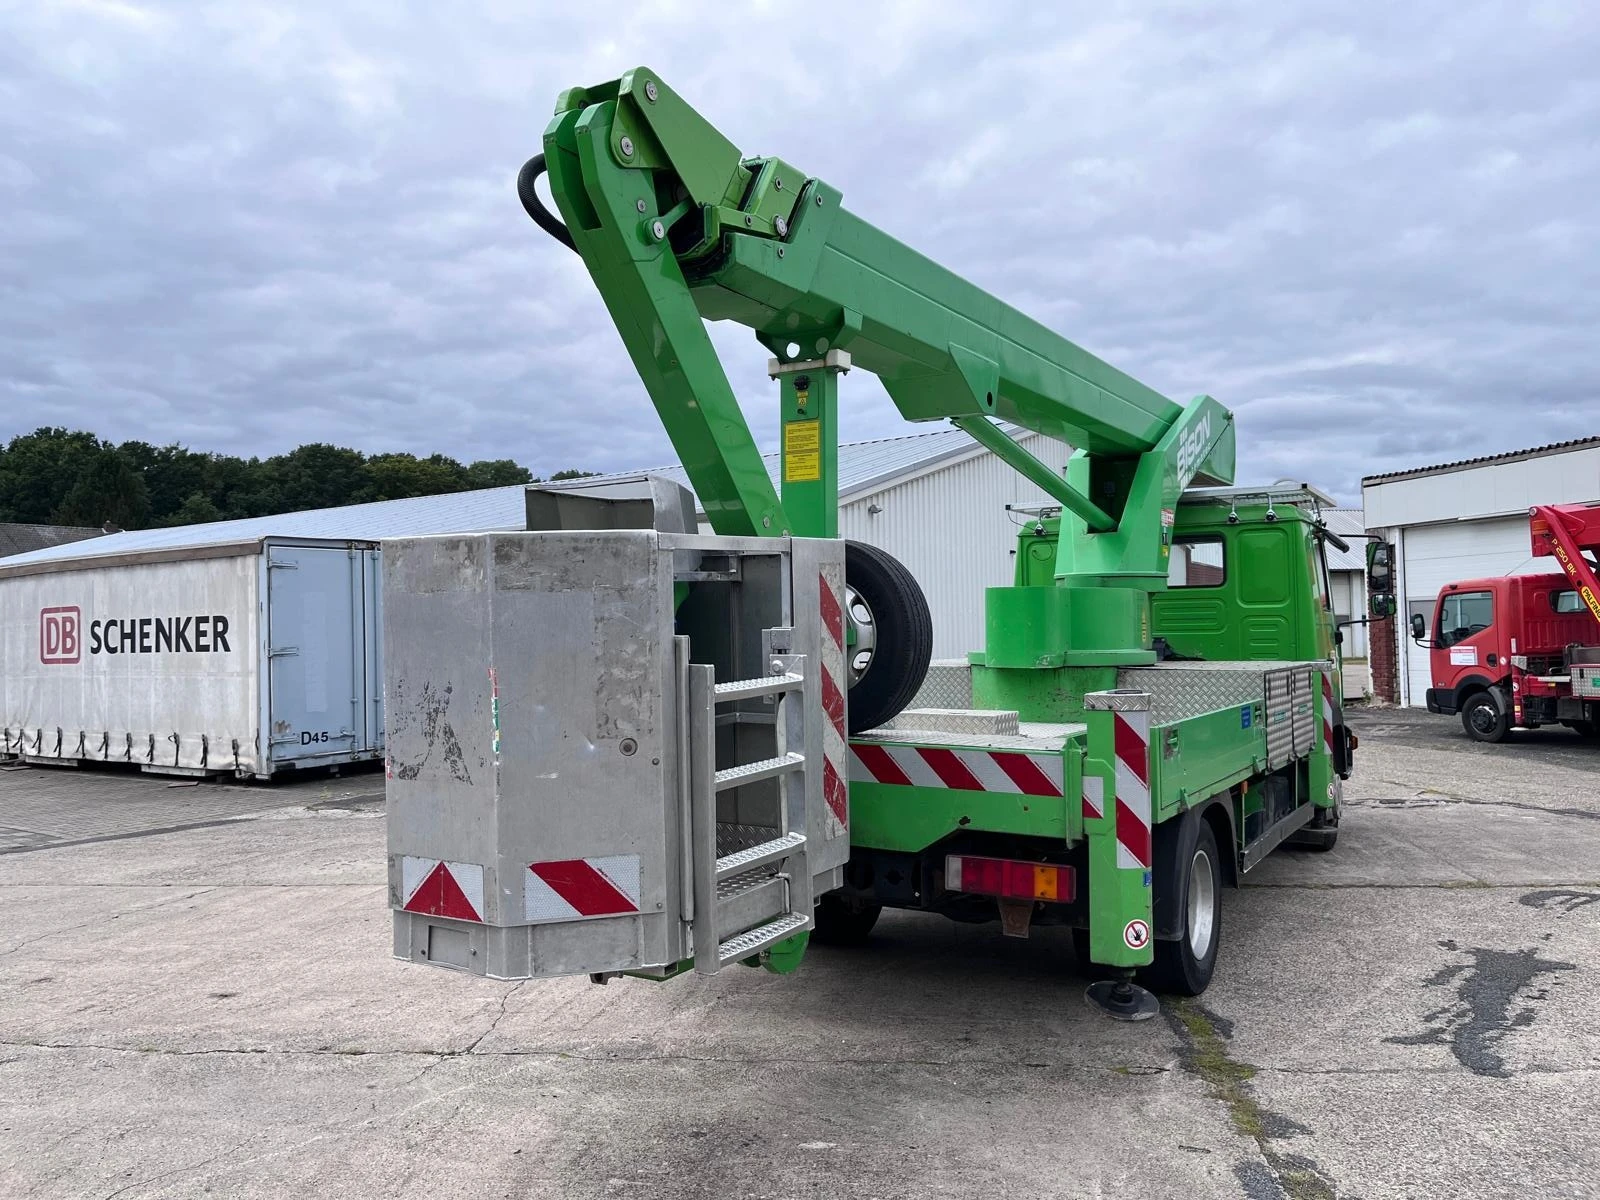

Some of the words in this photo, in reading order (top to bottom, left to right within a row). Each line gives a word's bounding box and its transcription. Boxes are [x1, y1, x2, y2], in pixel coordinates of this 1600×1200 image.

[1177, 410, 1211, 481] BISON
[1556, 545, 1569, 563] 250
[1566, 562, 1577, 576] BK
[45, 615, 77, 656] DB
[89, 615, 231, 655] SCHENKER
[301, 731, 329, 745] D45
